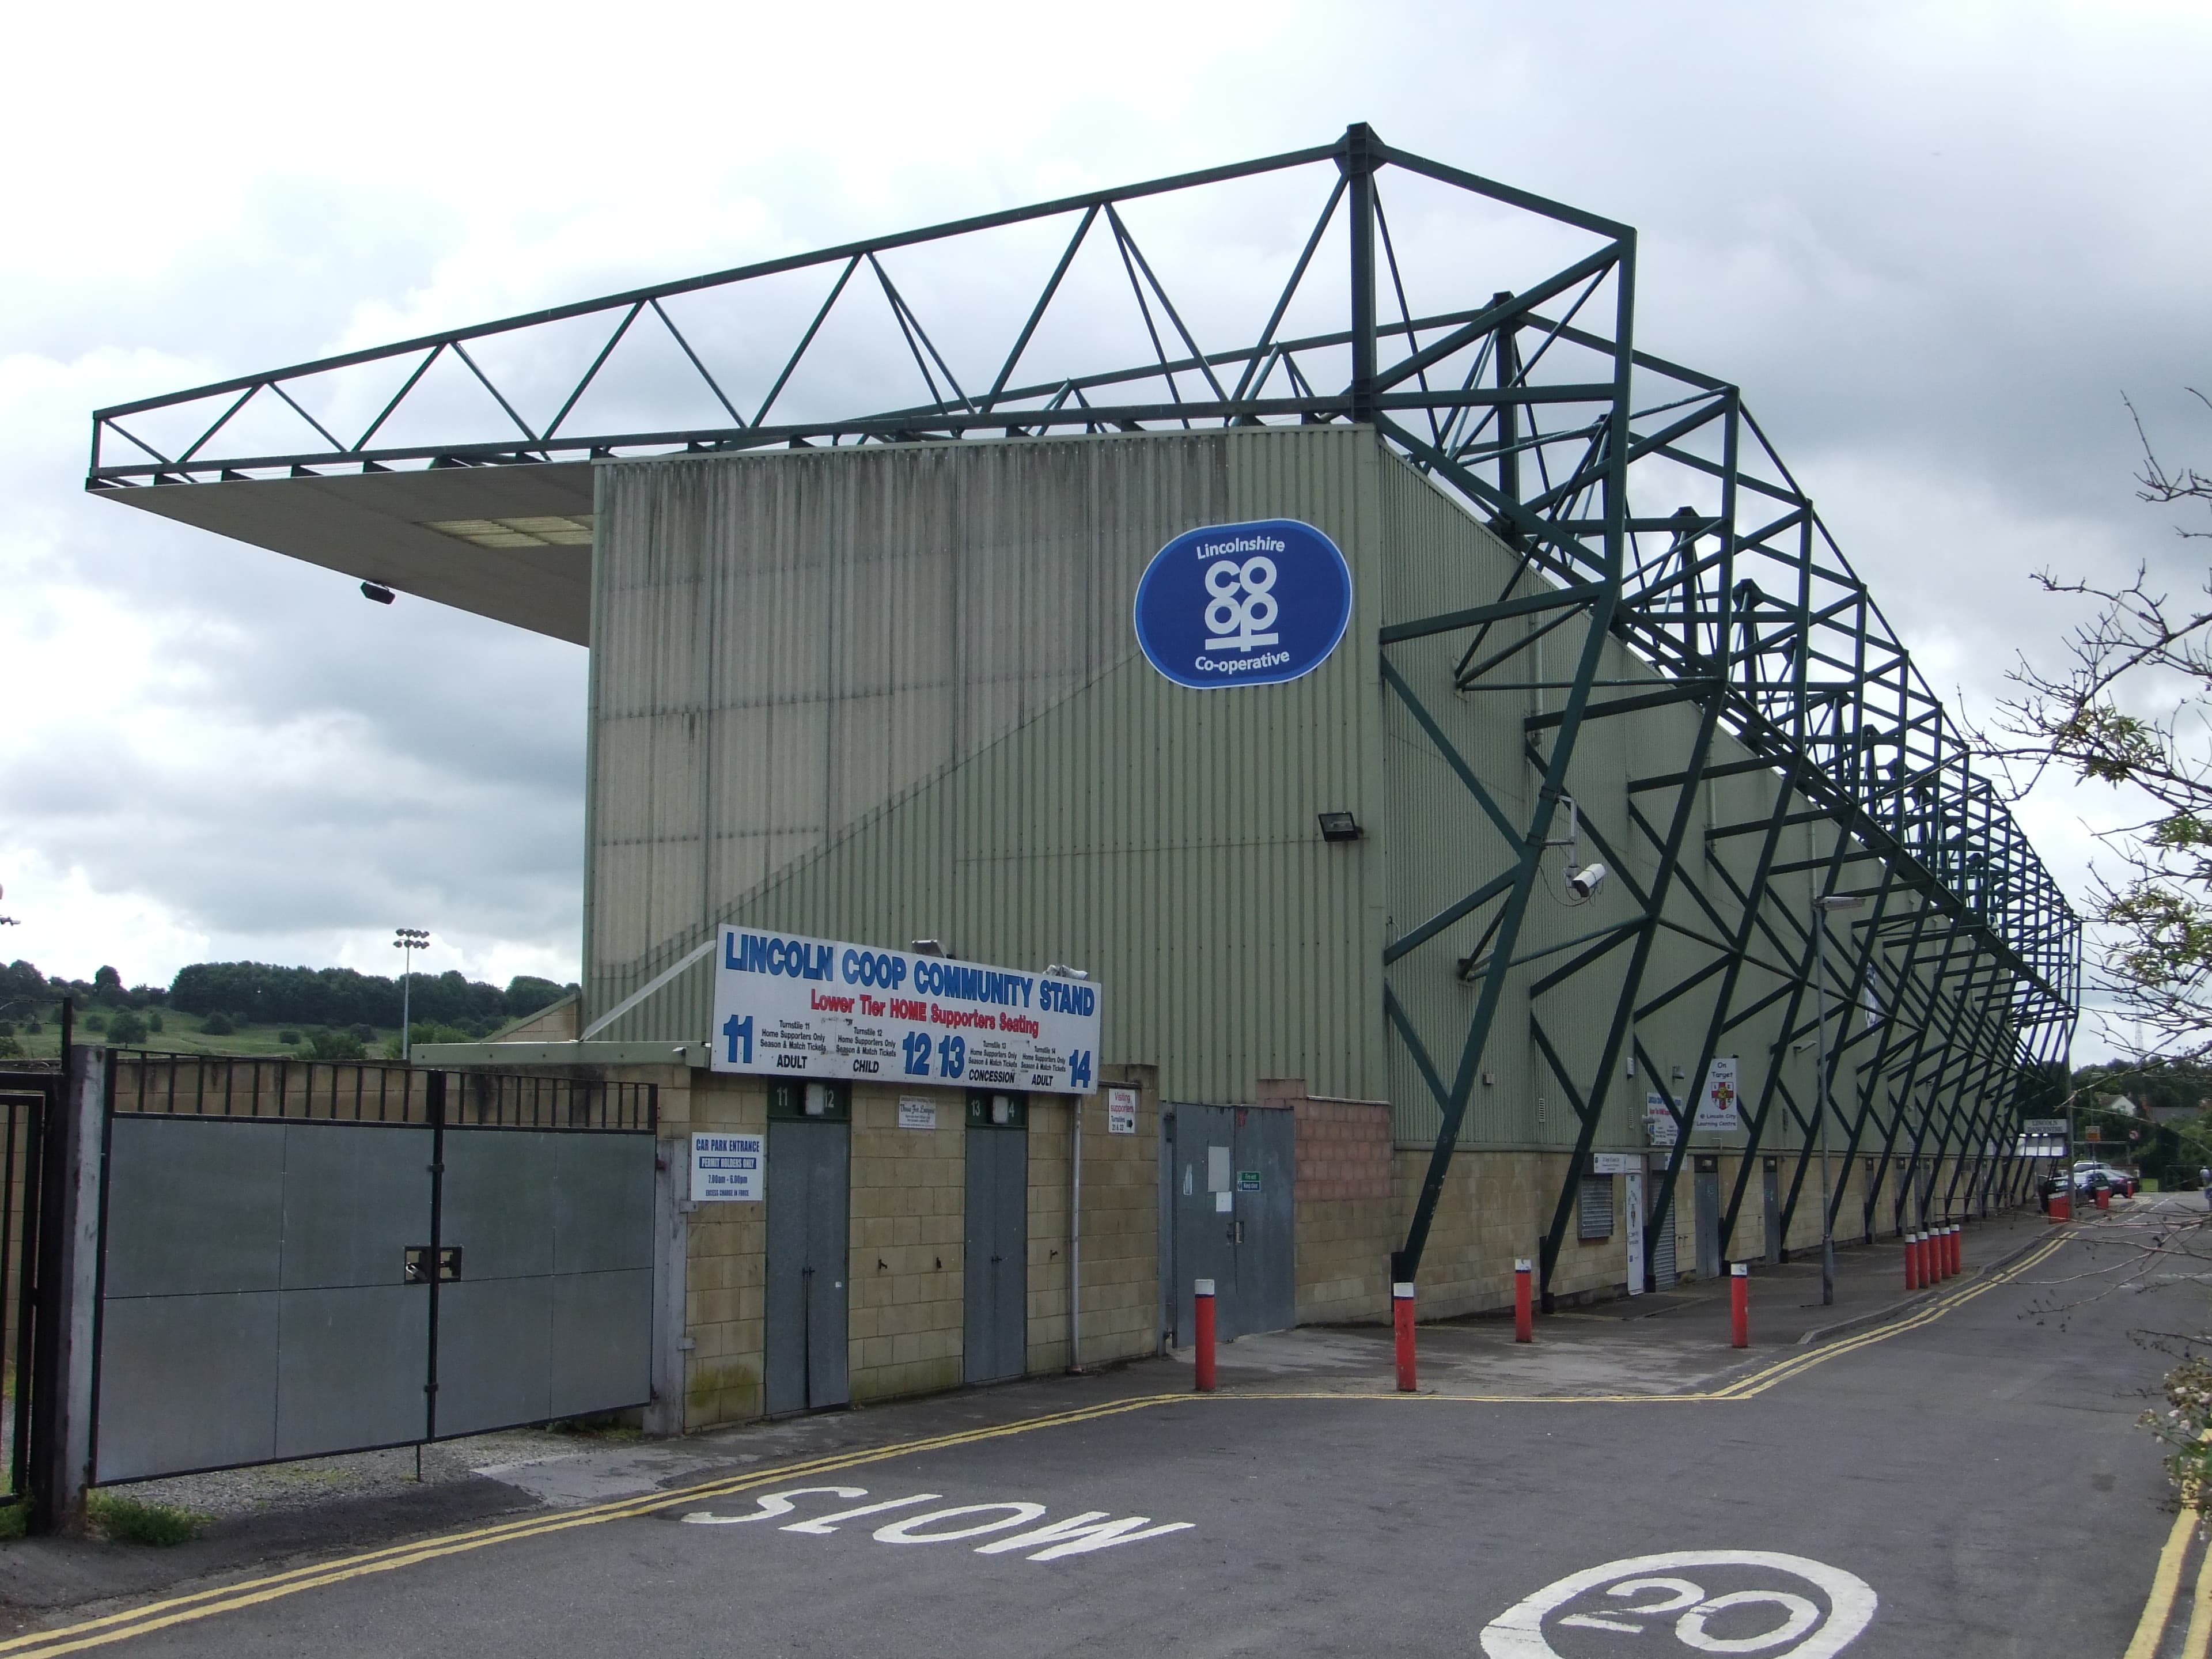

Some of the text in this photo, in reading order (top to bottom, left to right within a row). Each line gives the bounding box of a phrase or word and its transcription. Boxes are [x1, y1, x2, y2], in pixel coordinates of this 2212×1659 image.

[1196, 536, 1285, 560] Lincolnshire
[1195, 651, 1290, 675] Co-operative
[726, 932, 1094, 1017] LINCOLN COOP COMMUNITY STAND
[811, 988, 1039, 1039] Lower Tier HOME Supporters Seating
[779, 1020, 810, 1030] Turnstile 11
[854, 1027, 876, 1036] Turnstile
[724, 1014, 753, 1063] 11
[762, 1029, 825, 1042] Home Supporters Only
[838, 1035, 896, 1048] Home Supporters Only
[760, 1039, 781, 1048] Season
[789, 1041, 805, 1050] Match
[808, 1043, 826, 1051] Tickets
[836, 1044, 855, 1054] Season
[862, 1047, 877, 1055] Match
[880, 1048, 896, 1057] Tickets
[983, 1040, 1001, 1049] Turnstile
[1035, 1046, 1051, 1054] Turnstile
[902, 1031, 931, 1075] 12
[939, 1035, 965, 1079] 13
[984, 1050, 1007, 1059] Supporters
[1007, 1052, 1017, 1060] Only
[1035, 1054, 1056, 1063] Supporters
[1057, 1056, 1066, 1065] Only
[777, 1054, 807, 1069] ADULT
[853, 1059, 879, 1073] CHILD
[968, 1057, 984, 1065] Season
[990, 1059, 1002, 1067] Match
[1021, 1062, 1035, 1070] Season
[1040, 1063, 1052, 1071] Match
[1069, 1049, 1091, 1088] 14
[969, 1069, 1014, 1084] CONCESSION
[1032, 1074, 1053, 1086] ADULT
[777, 1087, 787, 1106] 11
[1115, 1092, 1130, 1103] Visiting
[971, 1100, 980, 1116] 13
[1111, 1105, 1134, 1114] supporters
[696, 1138, 759, 1152] CAR PARK ENTRANCE
[702, 1157, 754, 1168] PERMIT HOLDERS ONLY
[709, 1175, 725, 1183] 7.00am
[681, 1486, 1195, 1560] SLOW
[1557, 1577, 1820, 1653] 20
